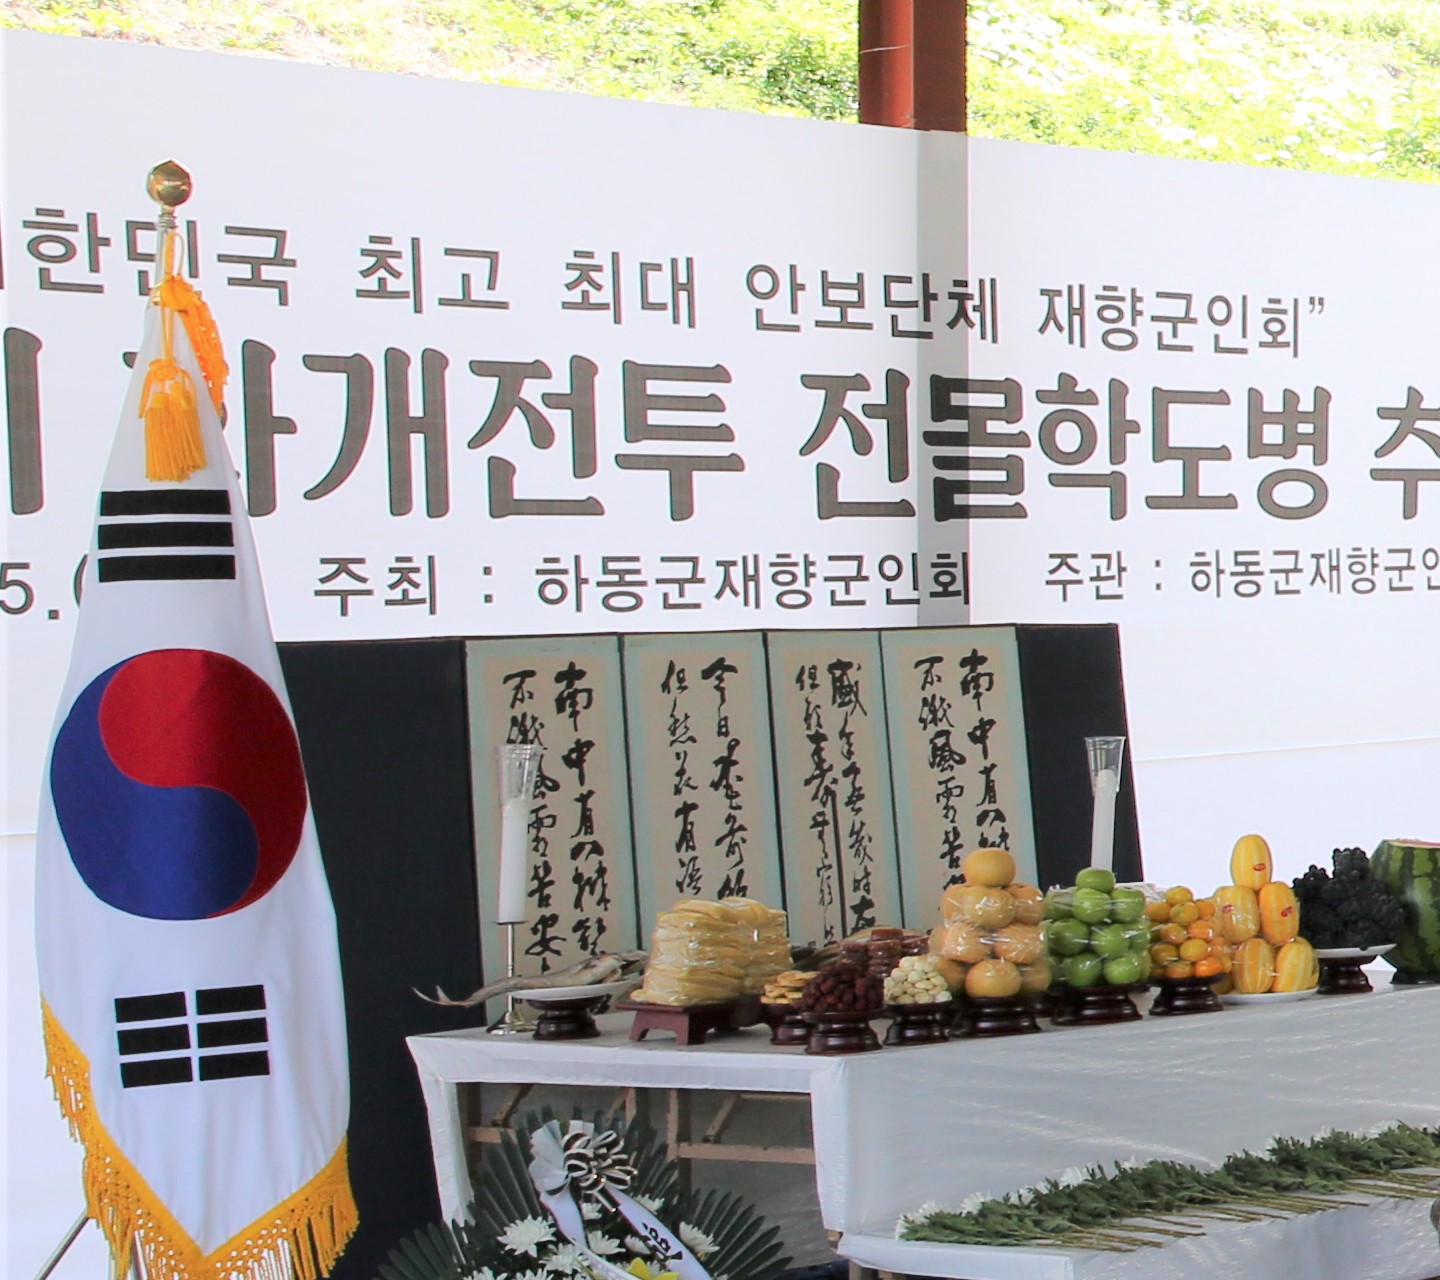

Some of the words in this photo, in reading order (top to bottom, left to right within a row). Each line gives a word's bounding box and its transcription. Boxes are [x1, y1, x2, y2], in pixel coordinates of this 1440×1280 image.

[0, 207, 298, 307] 한민국
[355, 235, 509, 314] 최고
[561, 250, 695, 329] 최대
[746, 264, 998, 344] 안보단체
[798, 368, 1332, 523] 전몰학도병
[314, 555, 437, 617] 주최
[535, 551, 971, 613] 하동군재향군인회
[1045, 551, 1128, 602] 주관
